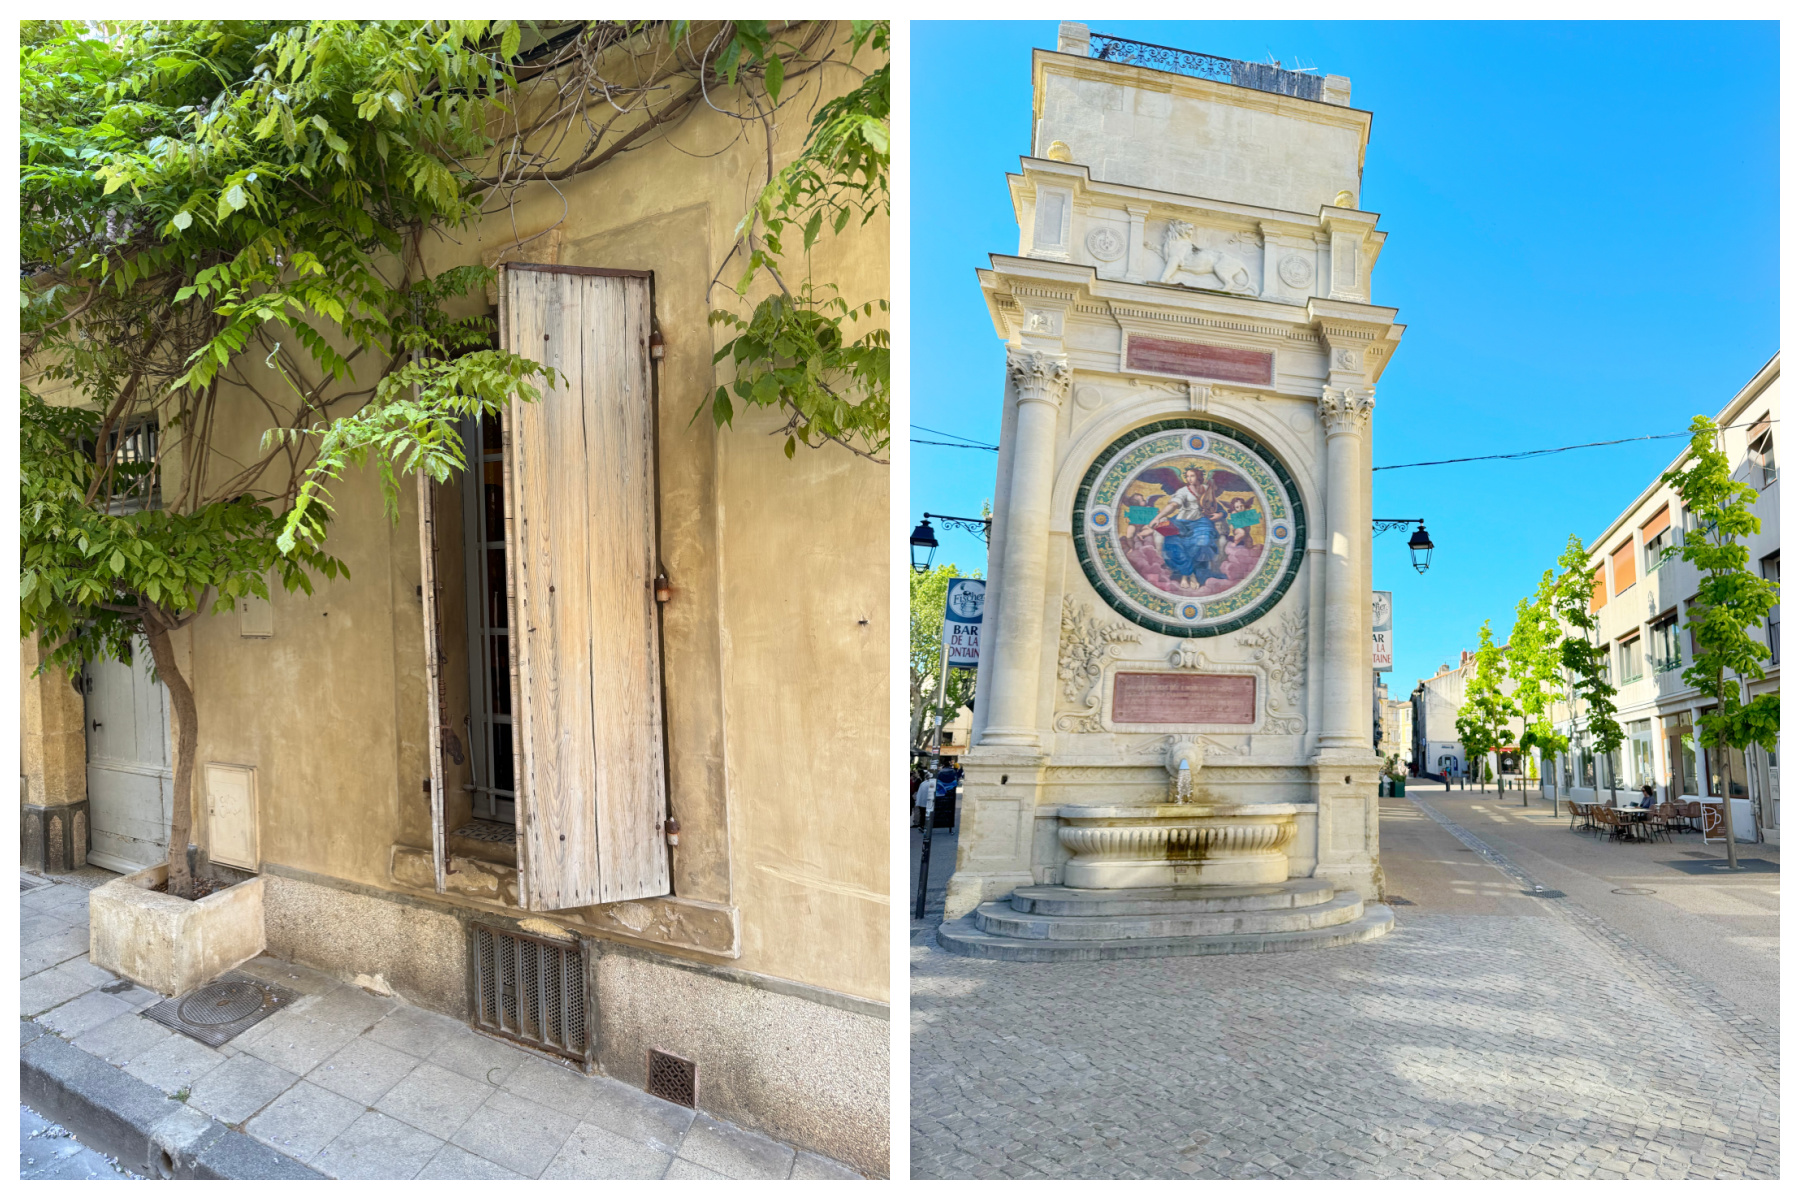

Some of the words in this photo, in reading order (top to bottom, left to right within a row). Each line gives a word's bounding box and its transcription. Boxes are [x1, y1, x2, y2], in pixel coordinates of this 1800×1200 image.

[953, 625, 978, 635] BAR
[951, 635, 962, 645] DE
[968, 636, 978, 647] LA
[1372, 634, 1384, 643] AR
[949, 646, 979, 658] ONTAIN
[1377, 644, 1385, 652] LA
[1373, 654, 1390, 663] TAINE
